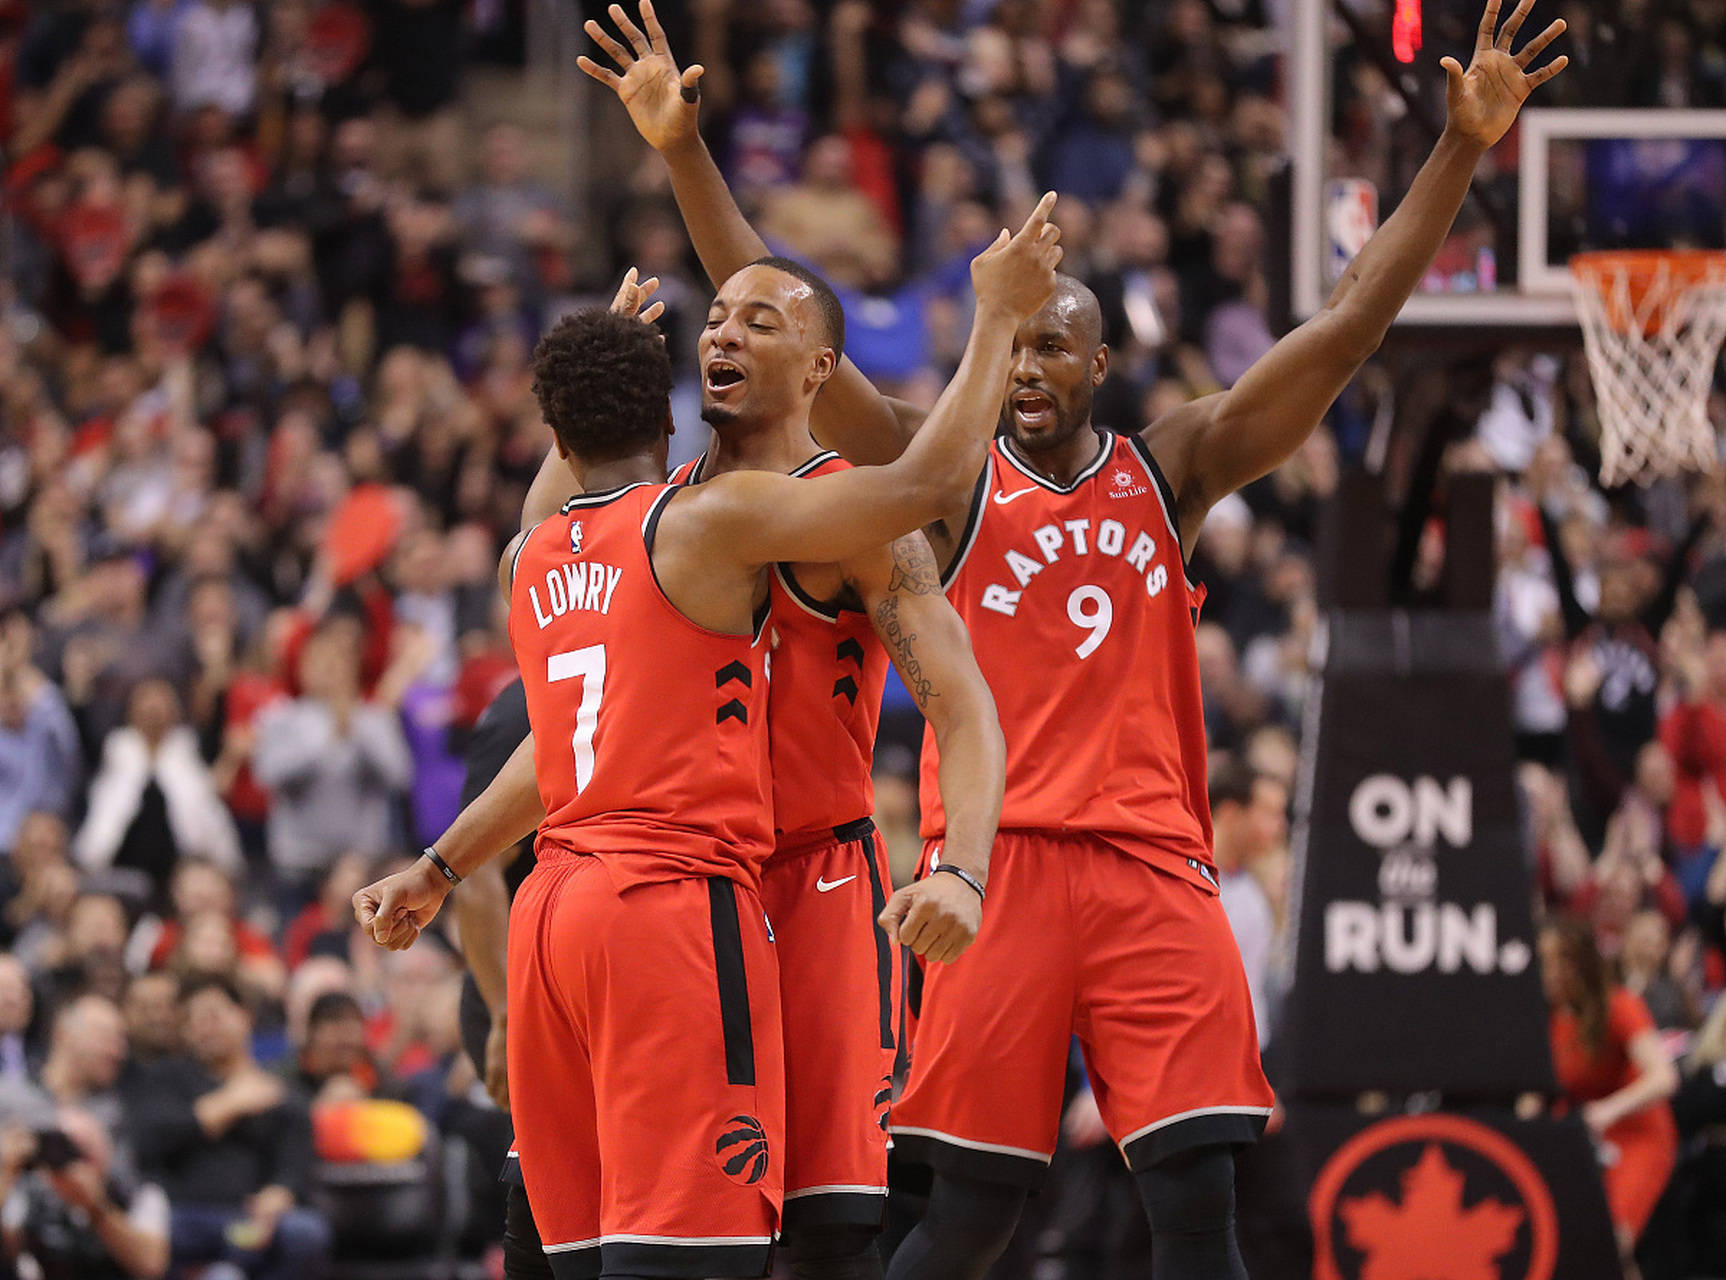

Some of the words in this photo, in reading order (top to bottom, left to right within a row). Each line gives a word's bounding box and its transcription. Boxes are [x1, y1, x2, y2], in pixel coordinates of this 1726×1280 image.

[1109, 491, 1129, 499] Sun
[1129, 485, 1147, 496] Life
[528, 561, 623, 630] LOWRY
[980, 519, 1169, 617] RAPTORS
[1067, 584, 1113, 660] 9
[547, 643, 606, 796] 7
[1349, 773, 1473, 848] ON
[1324, 900, 1532, 975] RUN.
